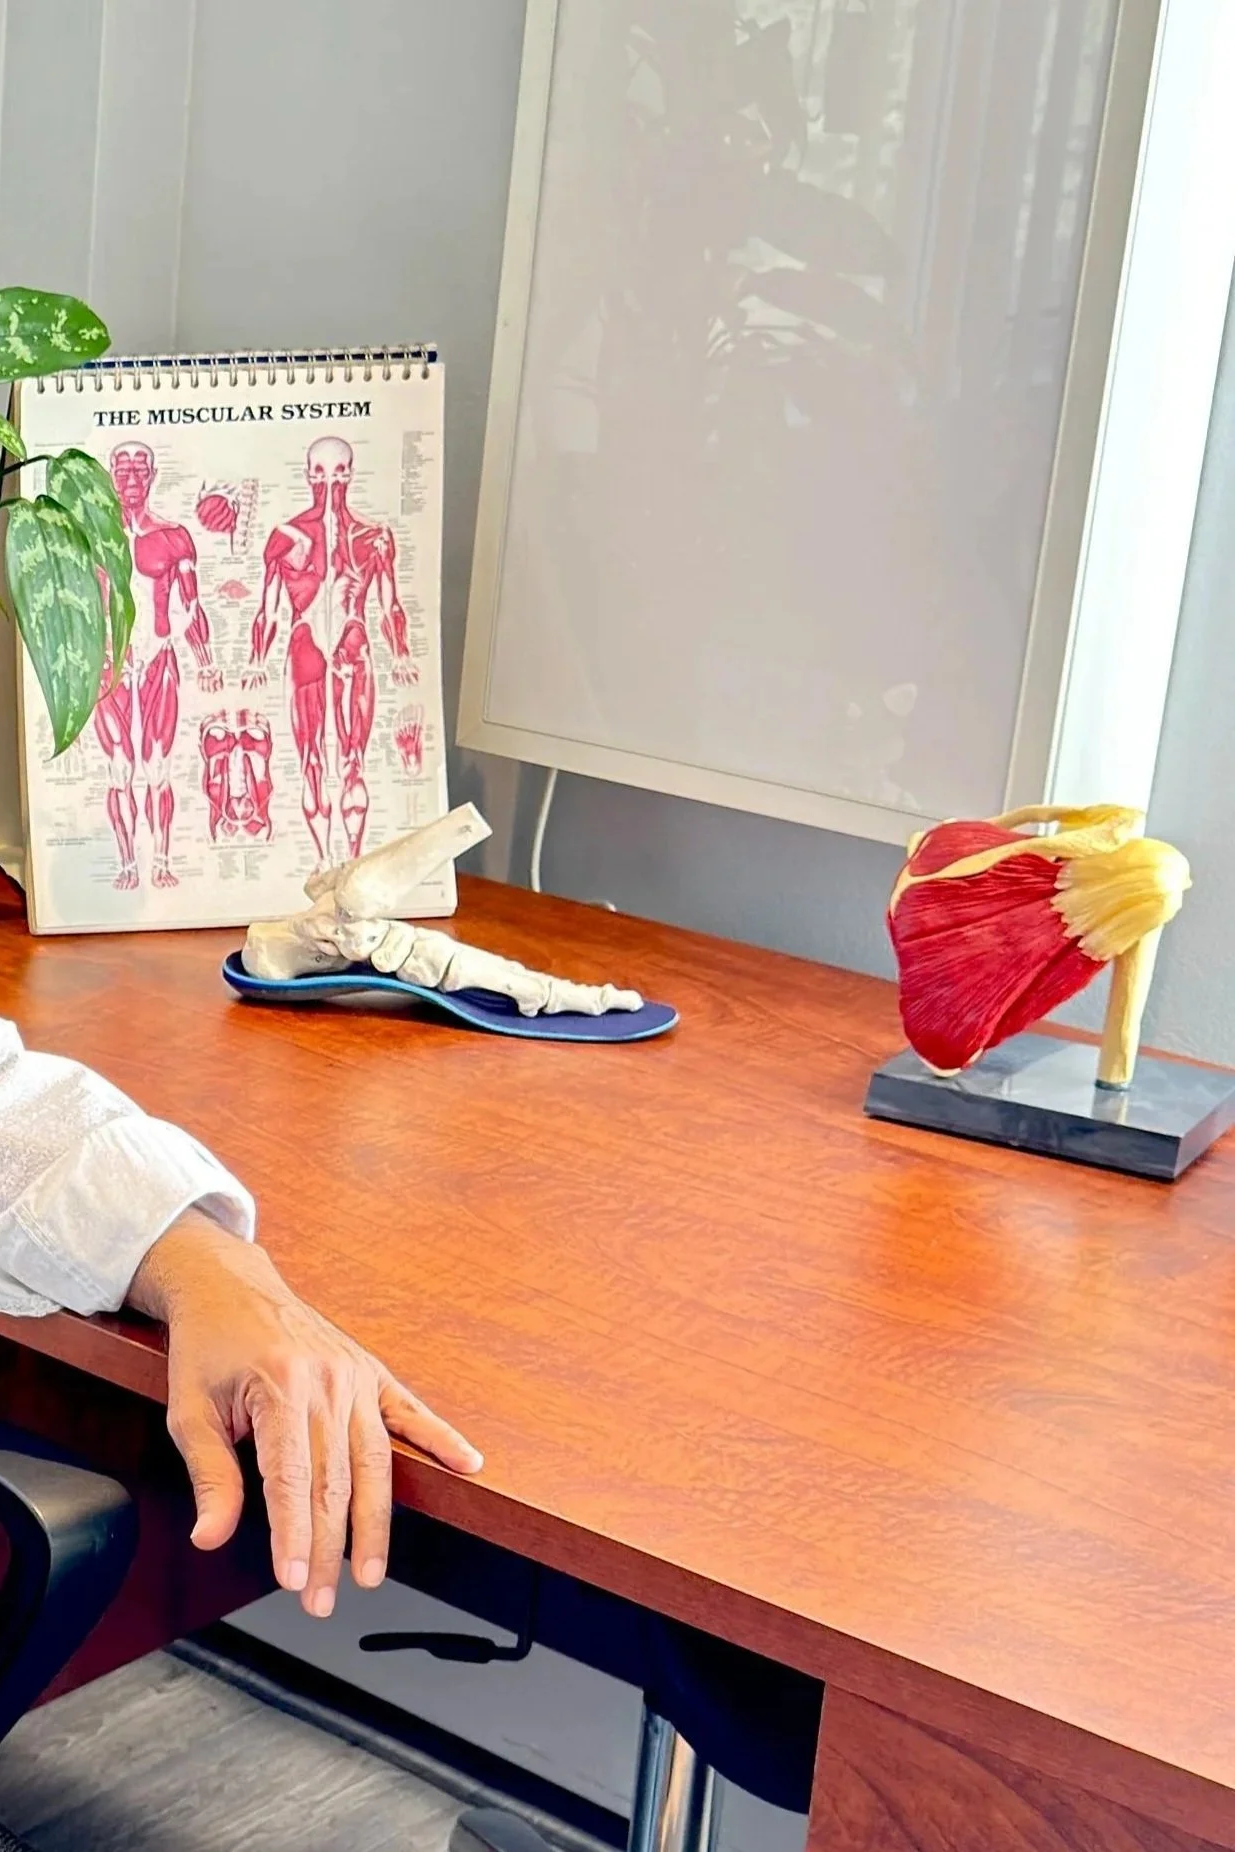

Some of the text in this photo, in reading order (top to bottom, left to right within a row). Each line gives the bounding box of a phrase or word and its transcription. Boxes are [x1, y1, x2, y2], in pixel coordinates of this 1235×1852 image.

[93, 401, 372, 426] THE MUSCULAR SYSTEM
